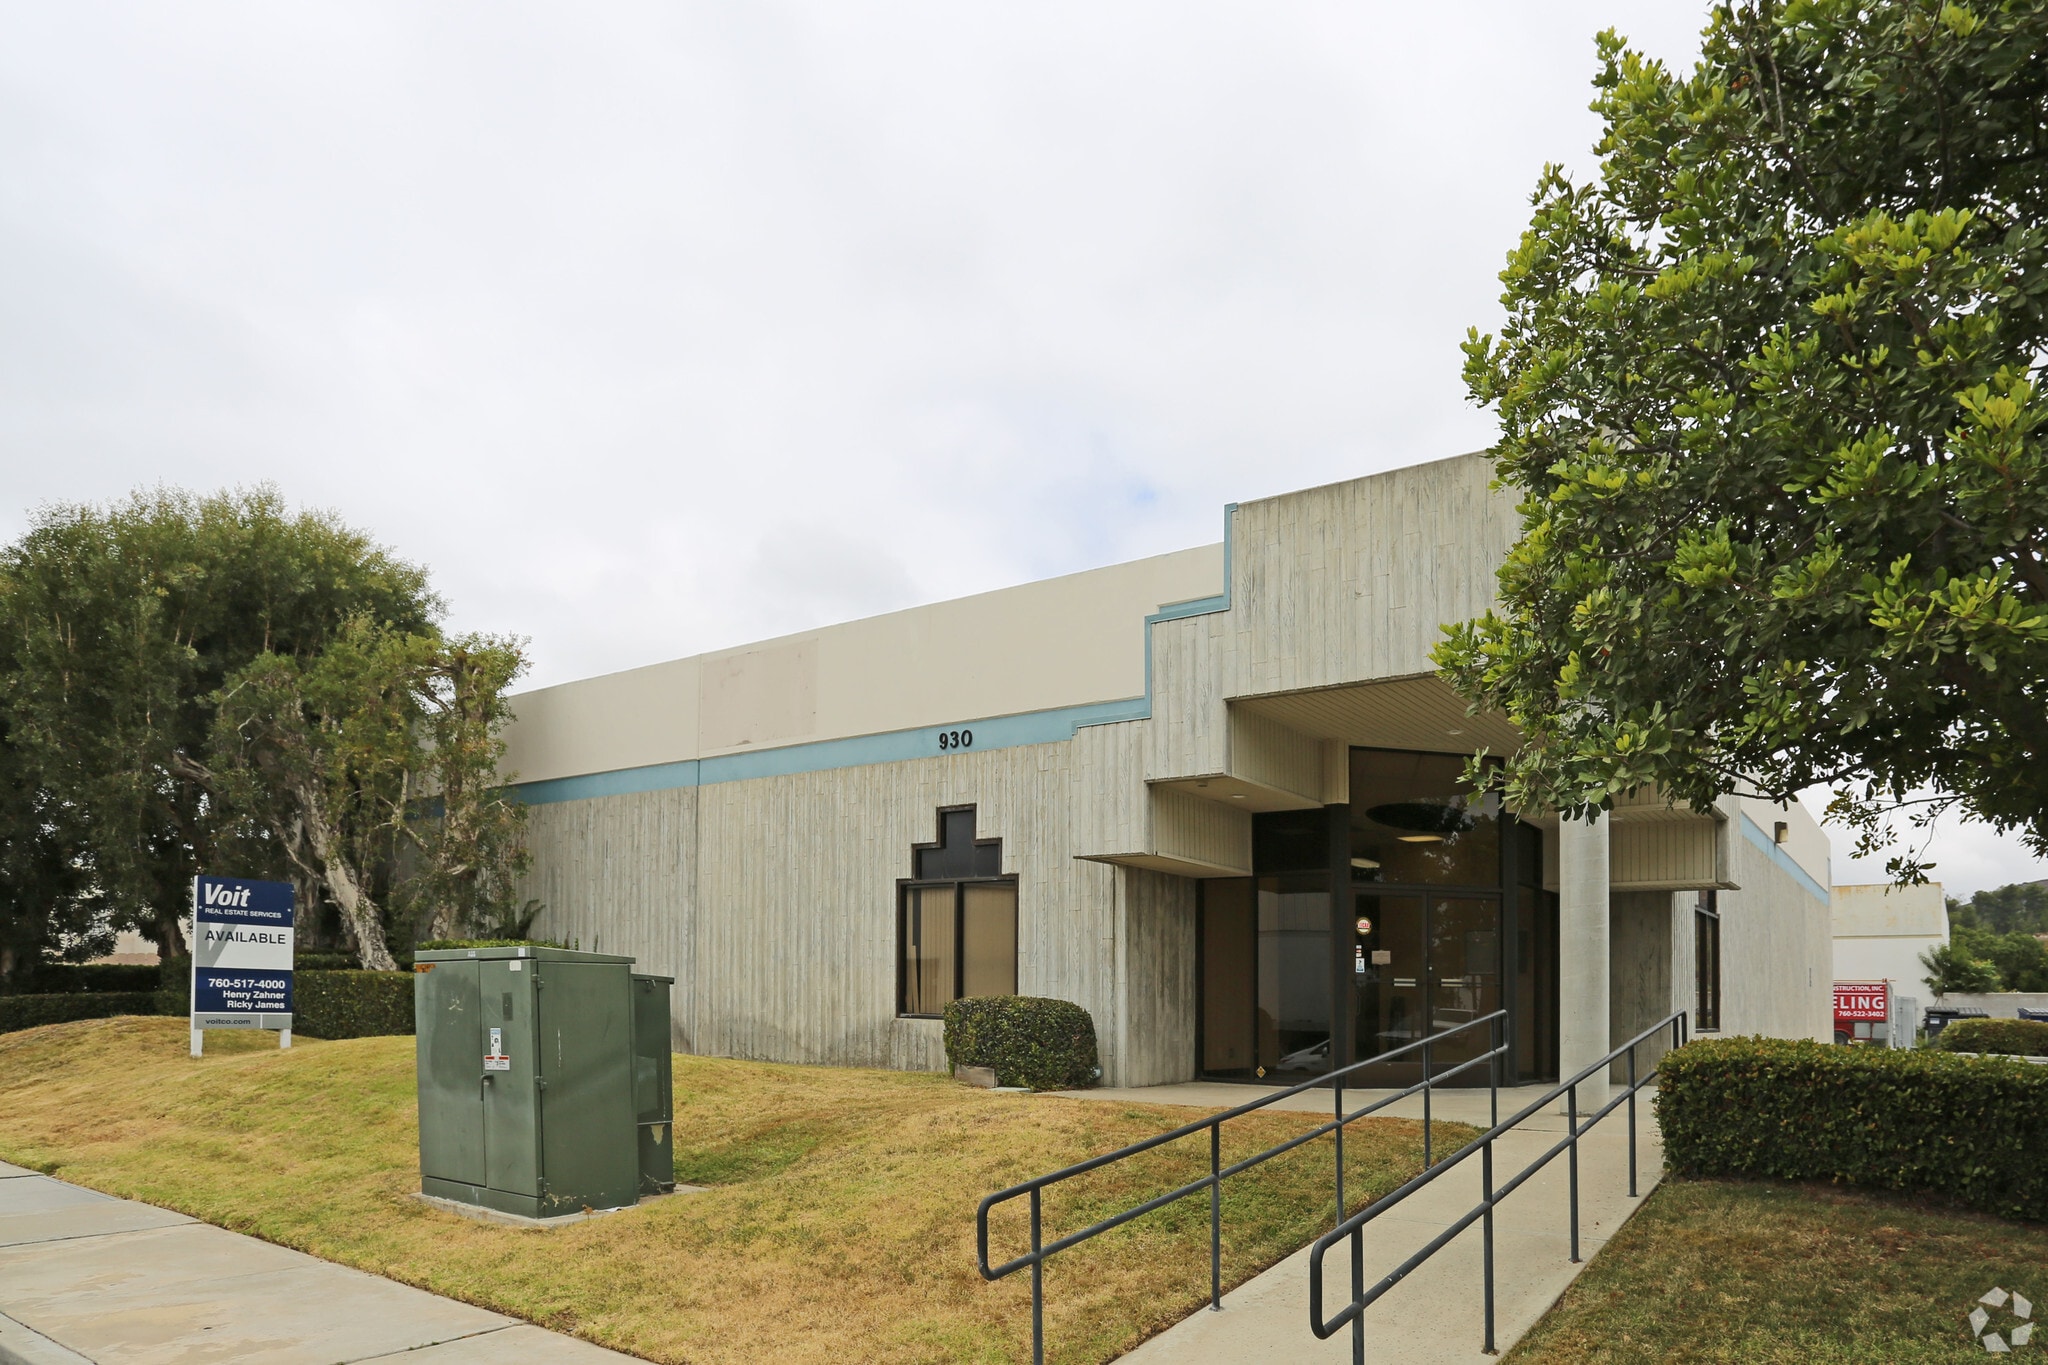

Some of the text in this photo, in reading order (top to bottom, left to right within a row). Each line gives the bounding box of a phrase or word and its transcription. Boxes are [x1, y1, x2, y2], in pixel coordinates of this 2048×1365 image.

[939, 729, 973, 750] 930
[205, 883, 251, 907] Voit
[224, 909, 248, 917] ESTATE
[205, 930, 286, 944] AVAILABLE
[208, 978, 286, 989] 760-517-4000
[223, 990, 285, 1000] Henry Zahner
[227, 1000, 285, 1010] Ricky James
